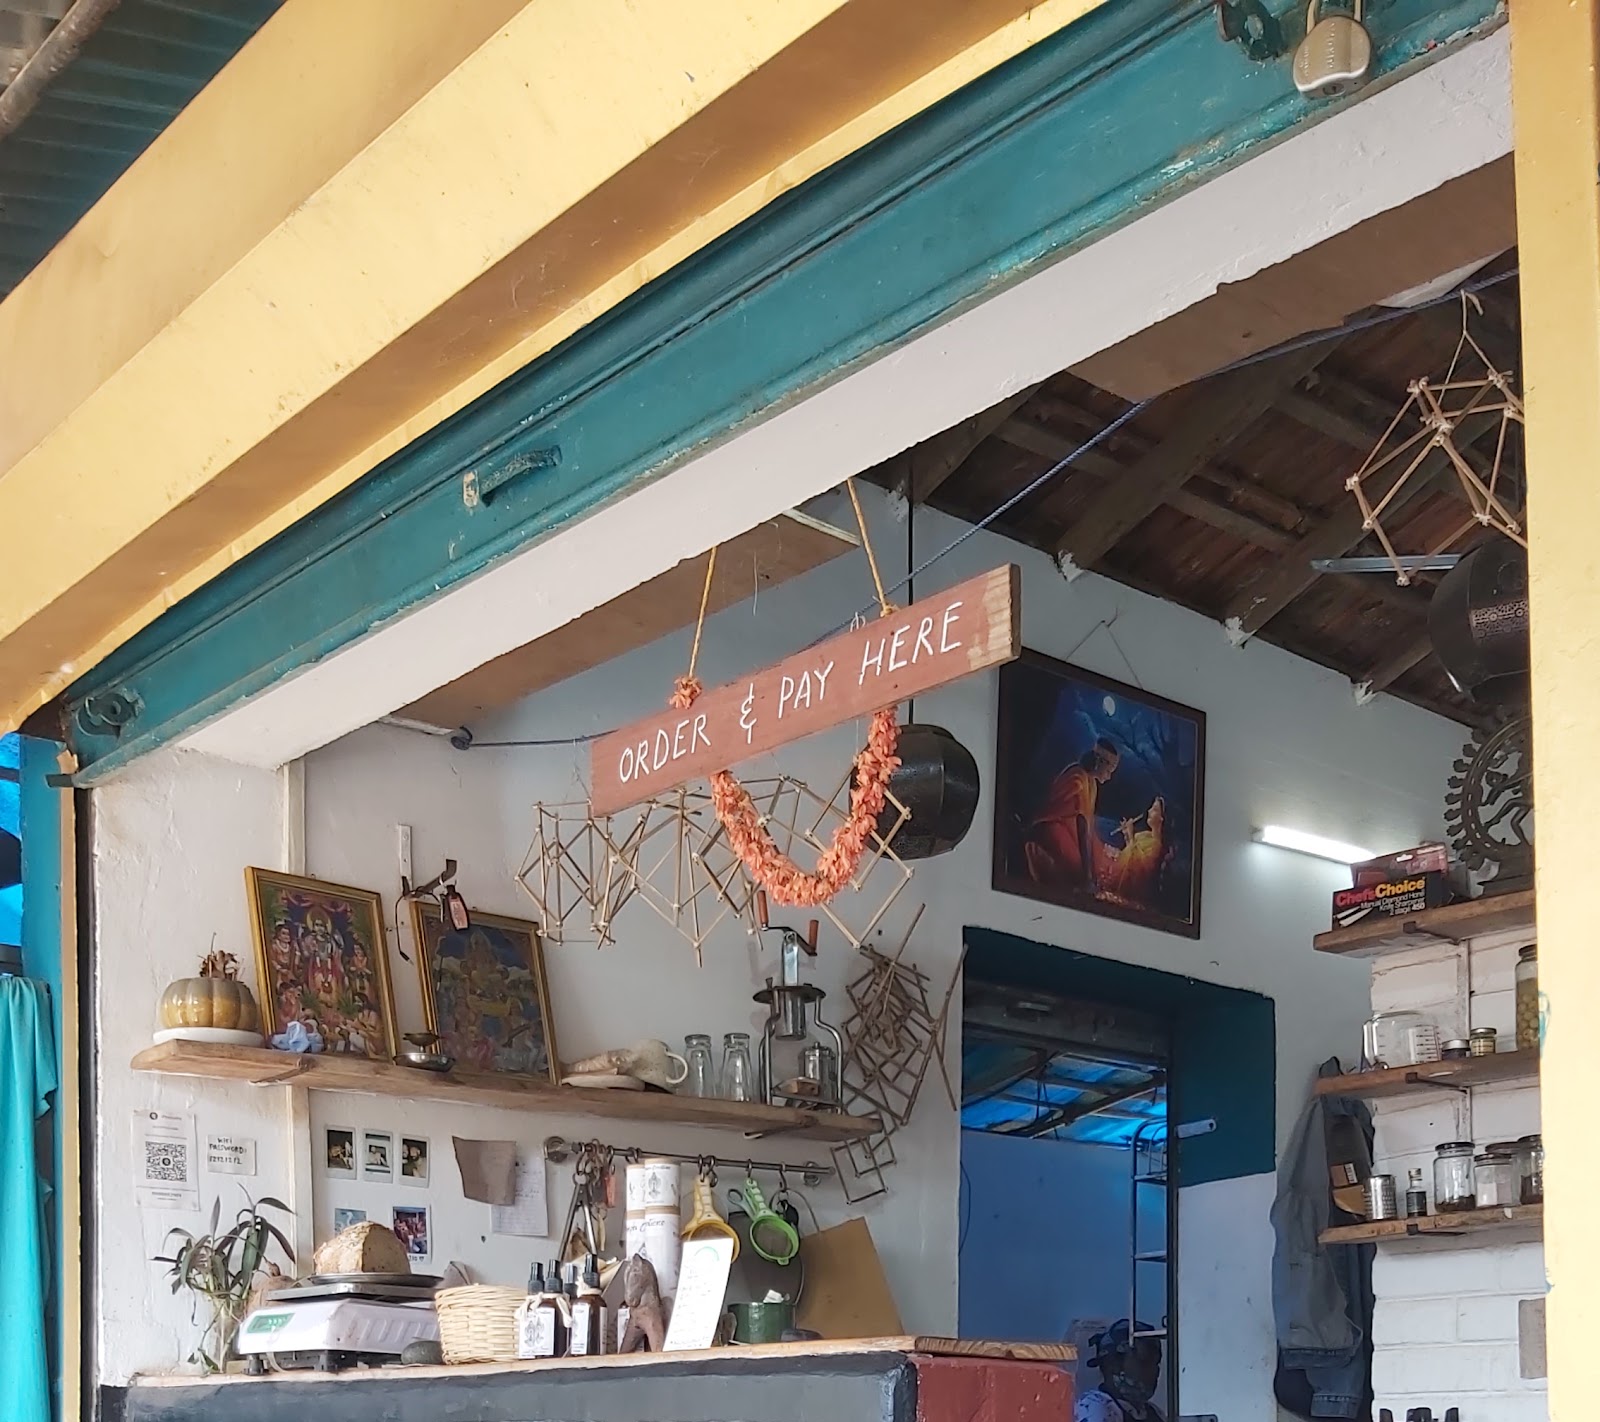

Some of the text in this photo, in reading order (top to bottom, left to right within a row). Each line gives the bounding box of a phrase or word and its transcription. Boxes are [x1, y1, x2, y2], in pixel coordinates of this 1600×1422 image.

[618, 602, 964, 784] ORDER & PAY HERE
